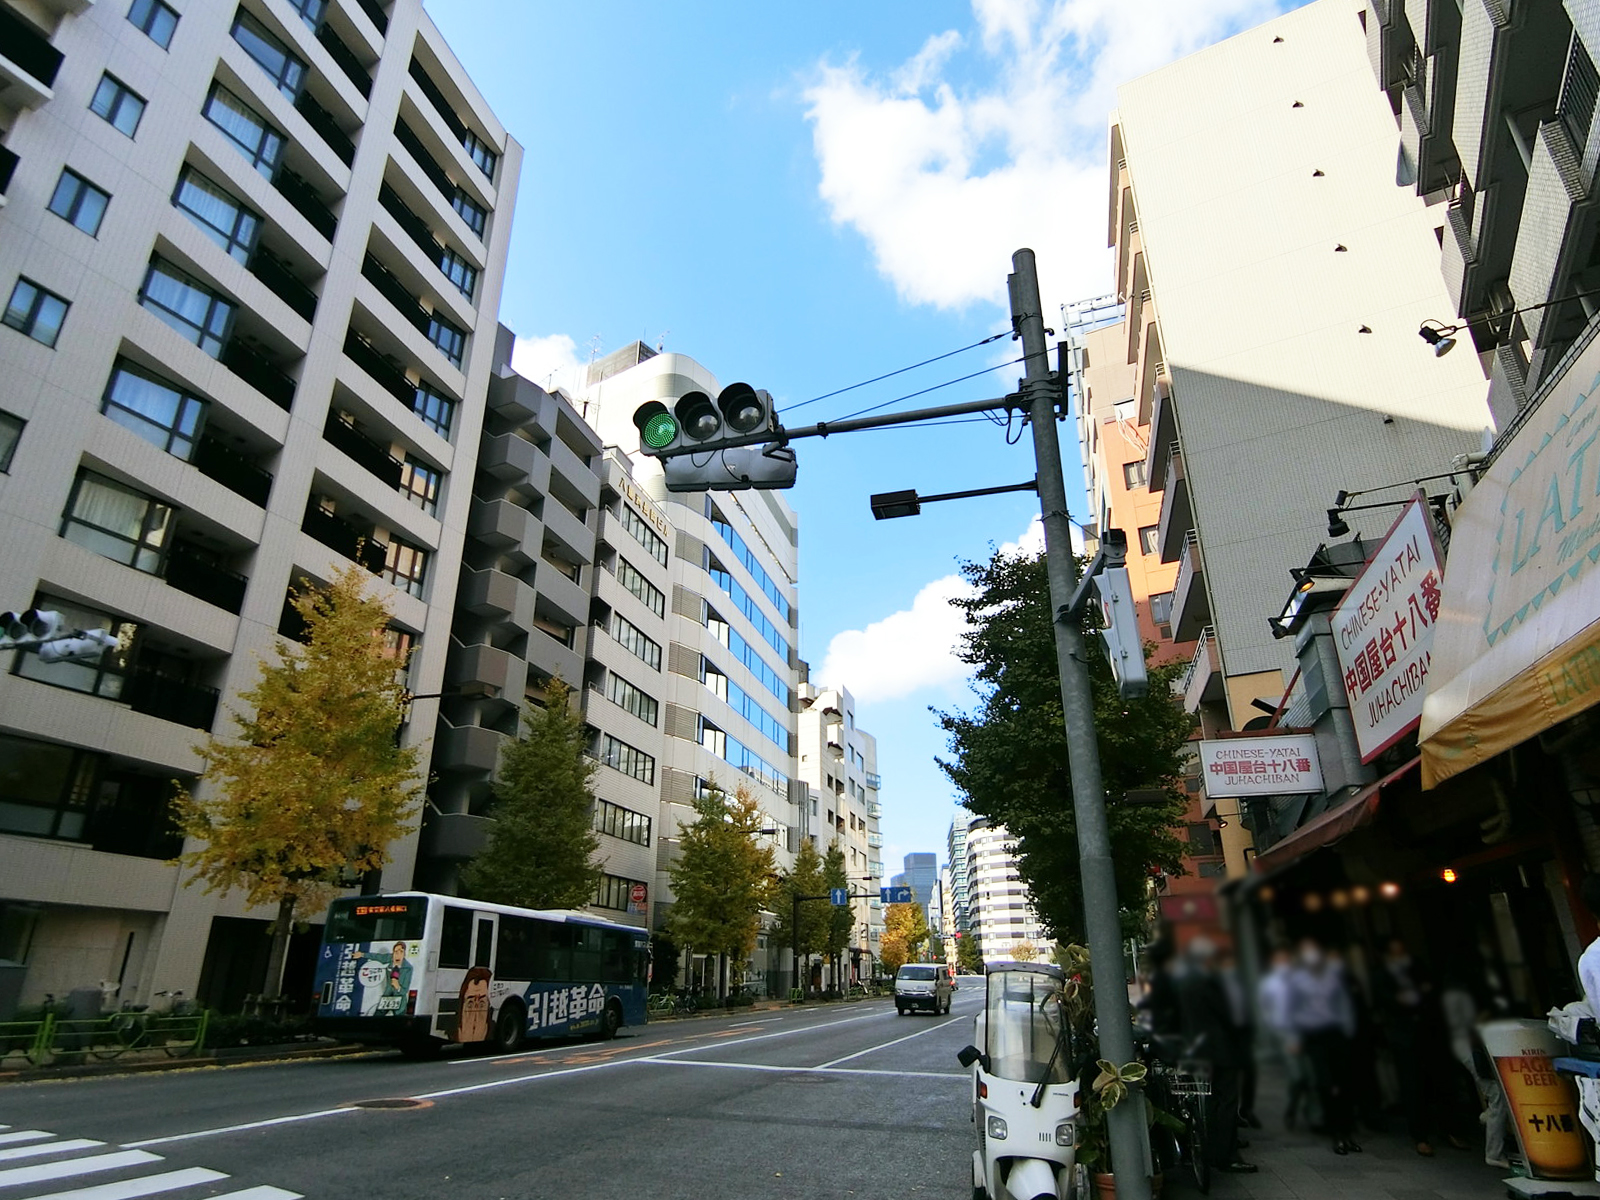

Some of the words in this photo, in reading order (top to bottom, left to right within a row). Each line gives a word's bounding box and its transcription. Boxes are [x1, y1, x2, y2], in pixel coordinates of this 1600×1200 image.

[1341, 534, 1421, 650] CHINESE-YATAI
[1344, 570, 1442, 702] 中国屋台十八番
[1215, 747, 1301, 760] CHINESE-YATAI
[1209, 757, 1311, 775] 中国屋台十八番
[1225, 773, 1300, 785] JUHACHIBAN
[335, 943, 360, 1011] 引越革命
[527, 983, 605, 1031] 引越革命
[1509, 1058, 1553, 1073] LAGE
[1523, 1073, 1558, 1086] BEER
